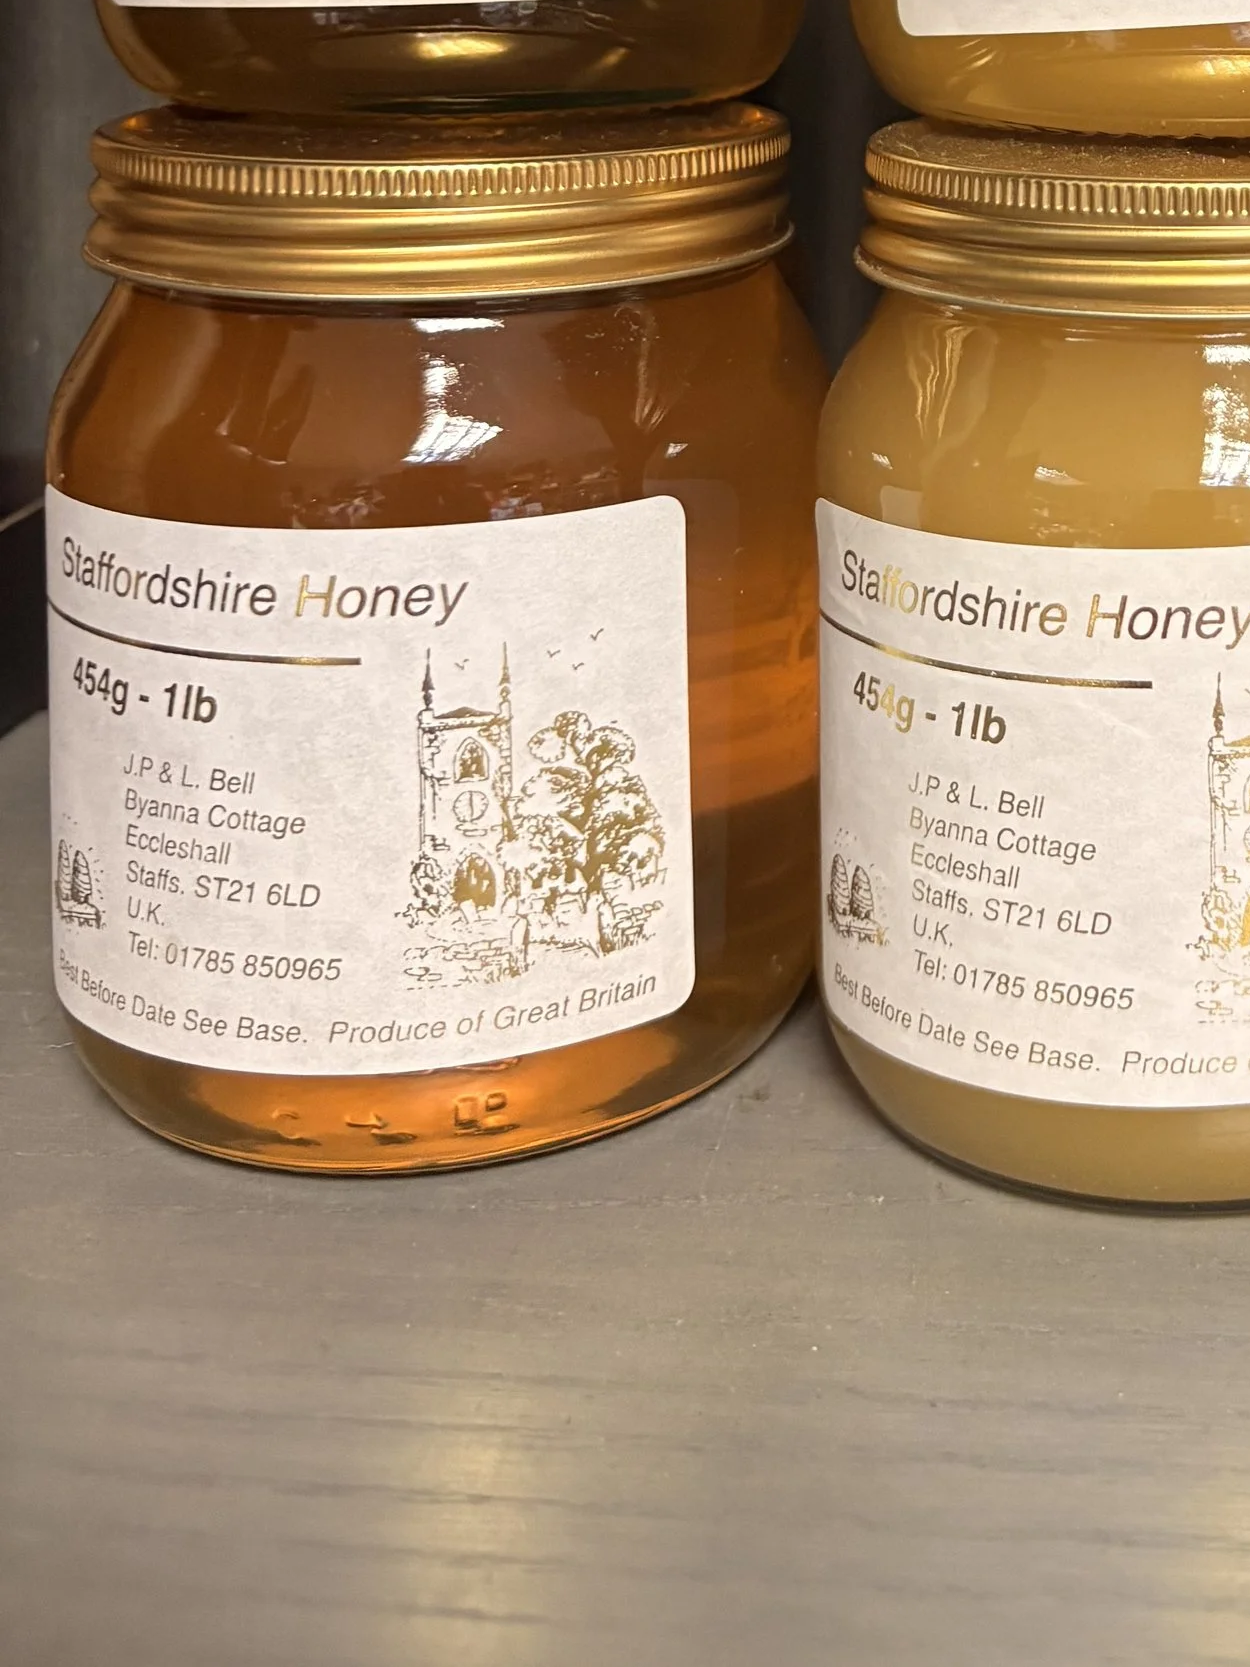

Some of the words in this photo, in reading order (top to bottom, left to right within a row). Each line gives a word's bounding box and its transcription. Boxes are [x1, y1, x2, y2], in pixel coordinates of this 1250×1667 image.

[62, 536, 276, 617] Staffordshire
[294, 575, 469, 626] Honey
[842, 549, 1067, 637] Staffordshire
[74, 657, 129, 715] 454g
[163, 682, 218, 723] 1lb
[853, 671, 915, 732] 454g
[951, 700, 1007, 745] 1lb
[124, 755, 153, 778] J.P
[181, 766, 199, 788] L.
[210, 769, 255, 795] Bell
[909, 772, 940, 799] J.P
[970, 787, 988, 811] L.
[999, 791, 1044, 819] Bell
[125, 788, 199, 825] Byanna
[208, 809, 306, 839] Cottage
[909, 807, 988, 846] Byanna
[997, 827, 1096, 863] Cottage
[126, 824, 230, 865] Eccleshall
[911, 845, 1020, 889] Eccleshall
[127, 861, 184, 896] Staffs.
[196, 874, 255, 904] ST21
[266, 881, 321, 908] 6LD
[984, 897, 1046, 930] ST21
[1057, 908, 1112, 936] 6LD
[129, 931, 158, 960] Tel:
[165, 943, 234, 974] 01785
[244, 954, 341, 981] 850965
[914, 950, 946, 981] Tel:
[954, 965, 1024, 999] 01785
[1033, 981, 1134, 1011] 850965
[82, 971, 126, 1012] Before
[132, 995, 176, 1028] Date
[183, 1010, 226, 1039] See
[236, 1016, 308, 1046] Base.
[329, 1017, 446, 1045] Produce
[457, 1008, 485, 1037] of
[494, 995, 570, 1030] Great
[579, 971, 656, 1014] Britain
[833, 962, 858, 1003] Best
[861, 986, 912, 1031] Before
[919, 1013, 965, 1049] Date
[973, 1030, 1018, 1060] See
[1029, 1042, 1100, 1072] Base.
[1122, 1049, 1237, 1076] Produce
